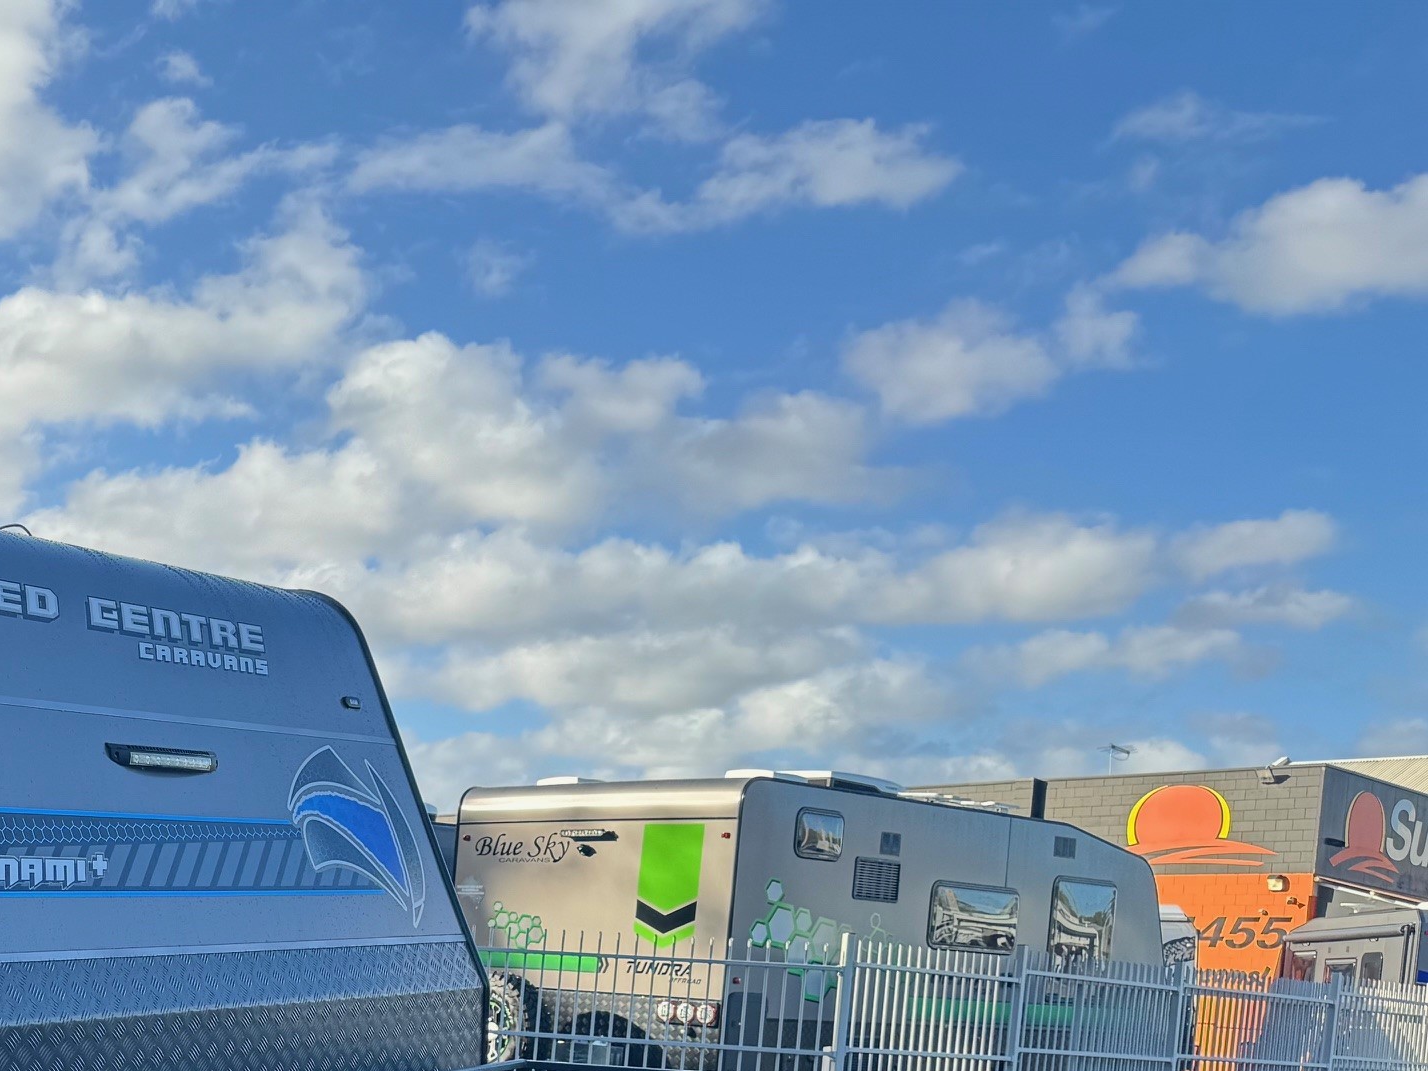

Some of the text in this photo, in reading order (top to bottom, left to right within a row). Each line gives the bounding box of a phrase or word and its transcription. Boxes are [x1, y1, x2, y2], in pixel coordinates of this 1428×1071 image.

[86, 596, 266, 652] CENTRE
[138, 642, 268, 674] CARAVANS
[475, 833, 570, 863] Blue Sky
[1186, 916, 1293, 949] 455
[626, 961, 691, 977] TUNDRA
